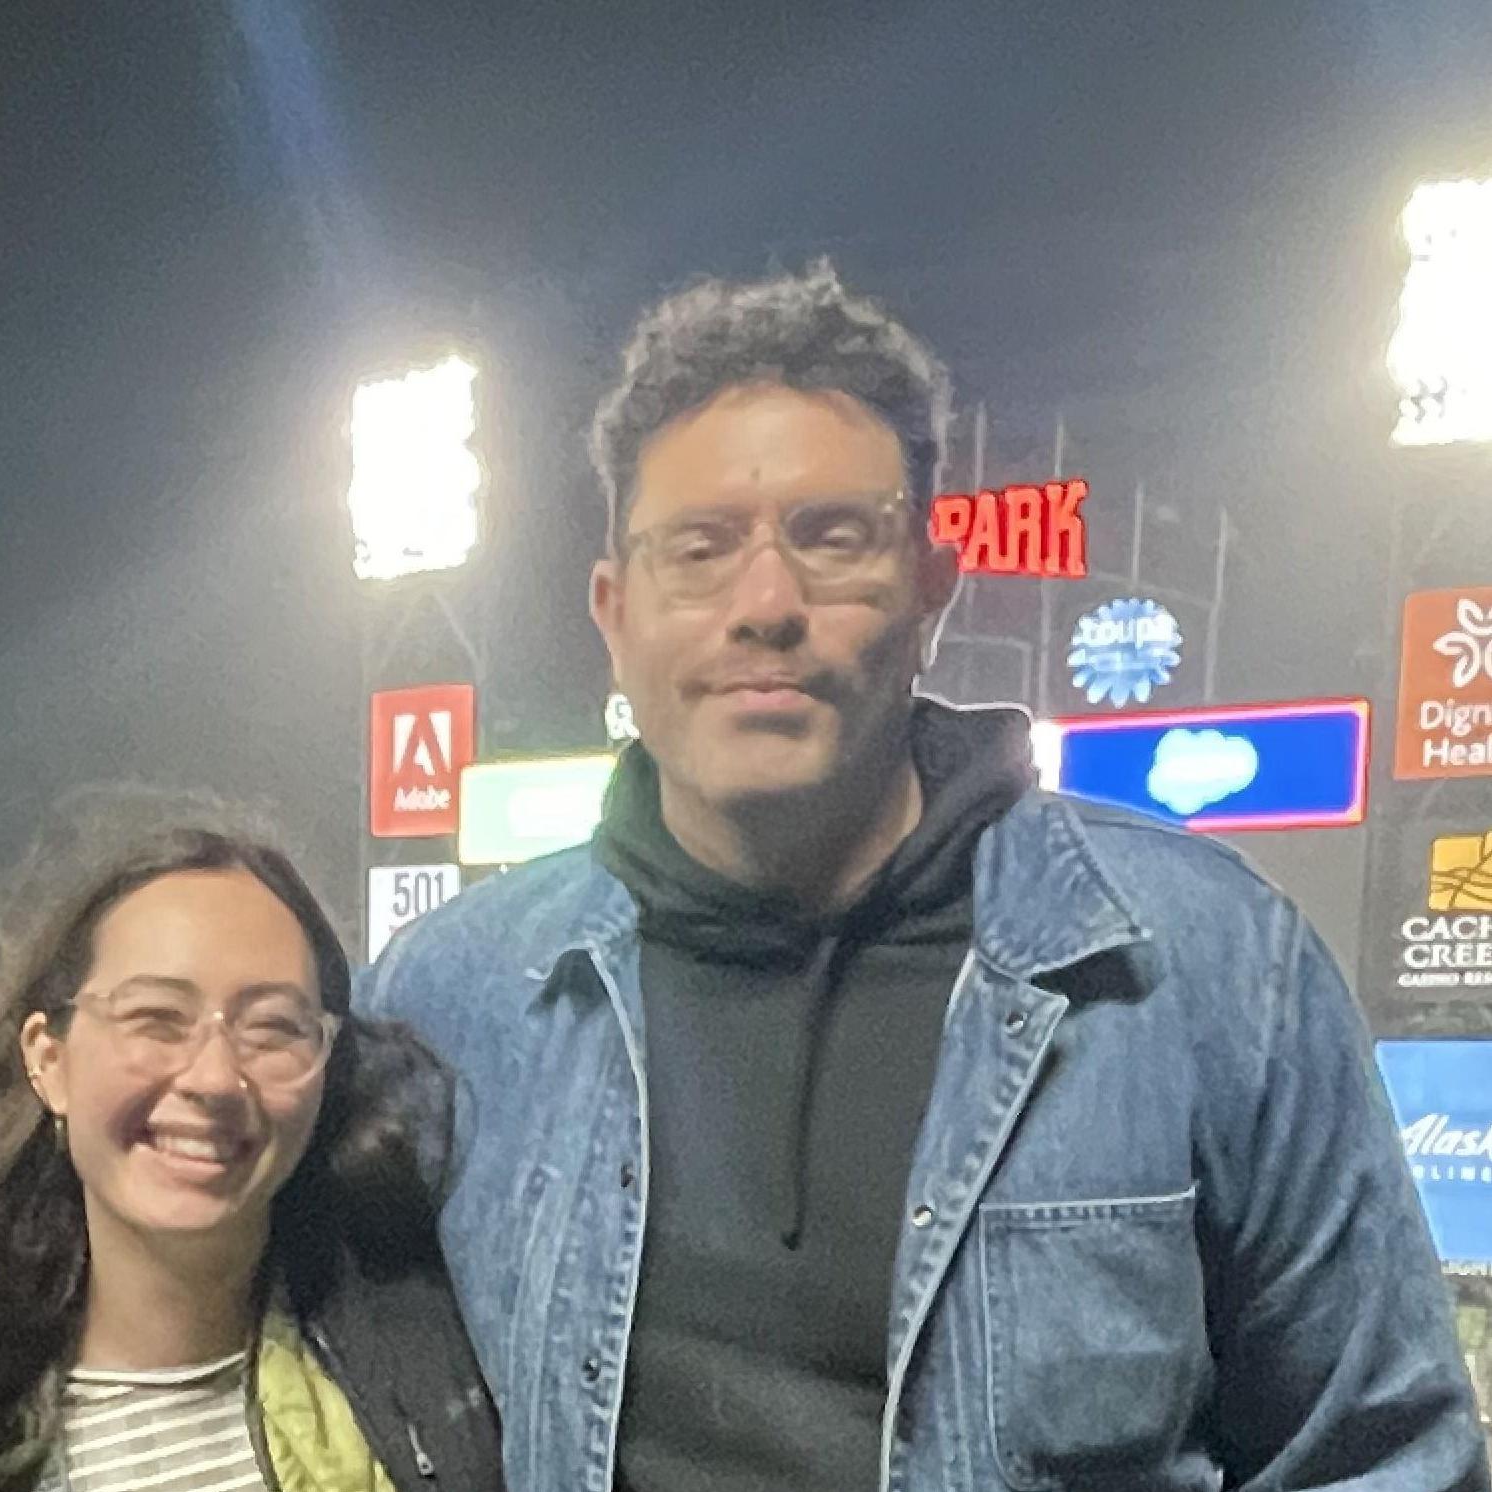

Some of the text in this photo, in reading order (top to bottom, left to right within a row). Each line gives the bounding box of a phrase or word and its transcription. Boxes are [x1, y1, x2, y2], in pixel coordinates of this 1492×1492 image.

[932, 481, 1089, 579] PARK
[1420, 698, 1492, 736] Dign
[393, 785, 452, 812] Adobe
[393, 872, 445, 917] 501
